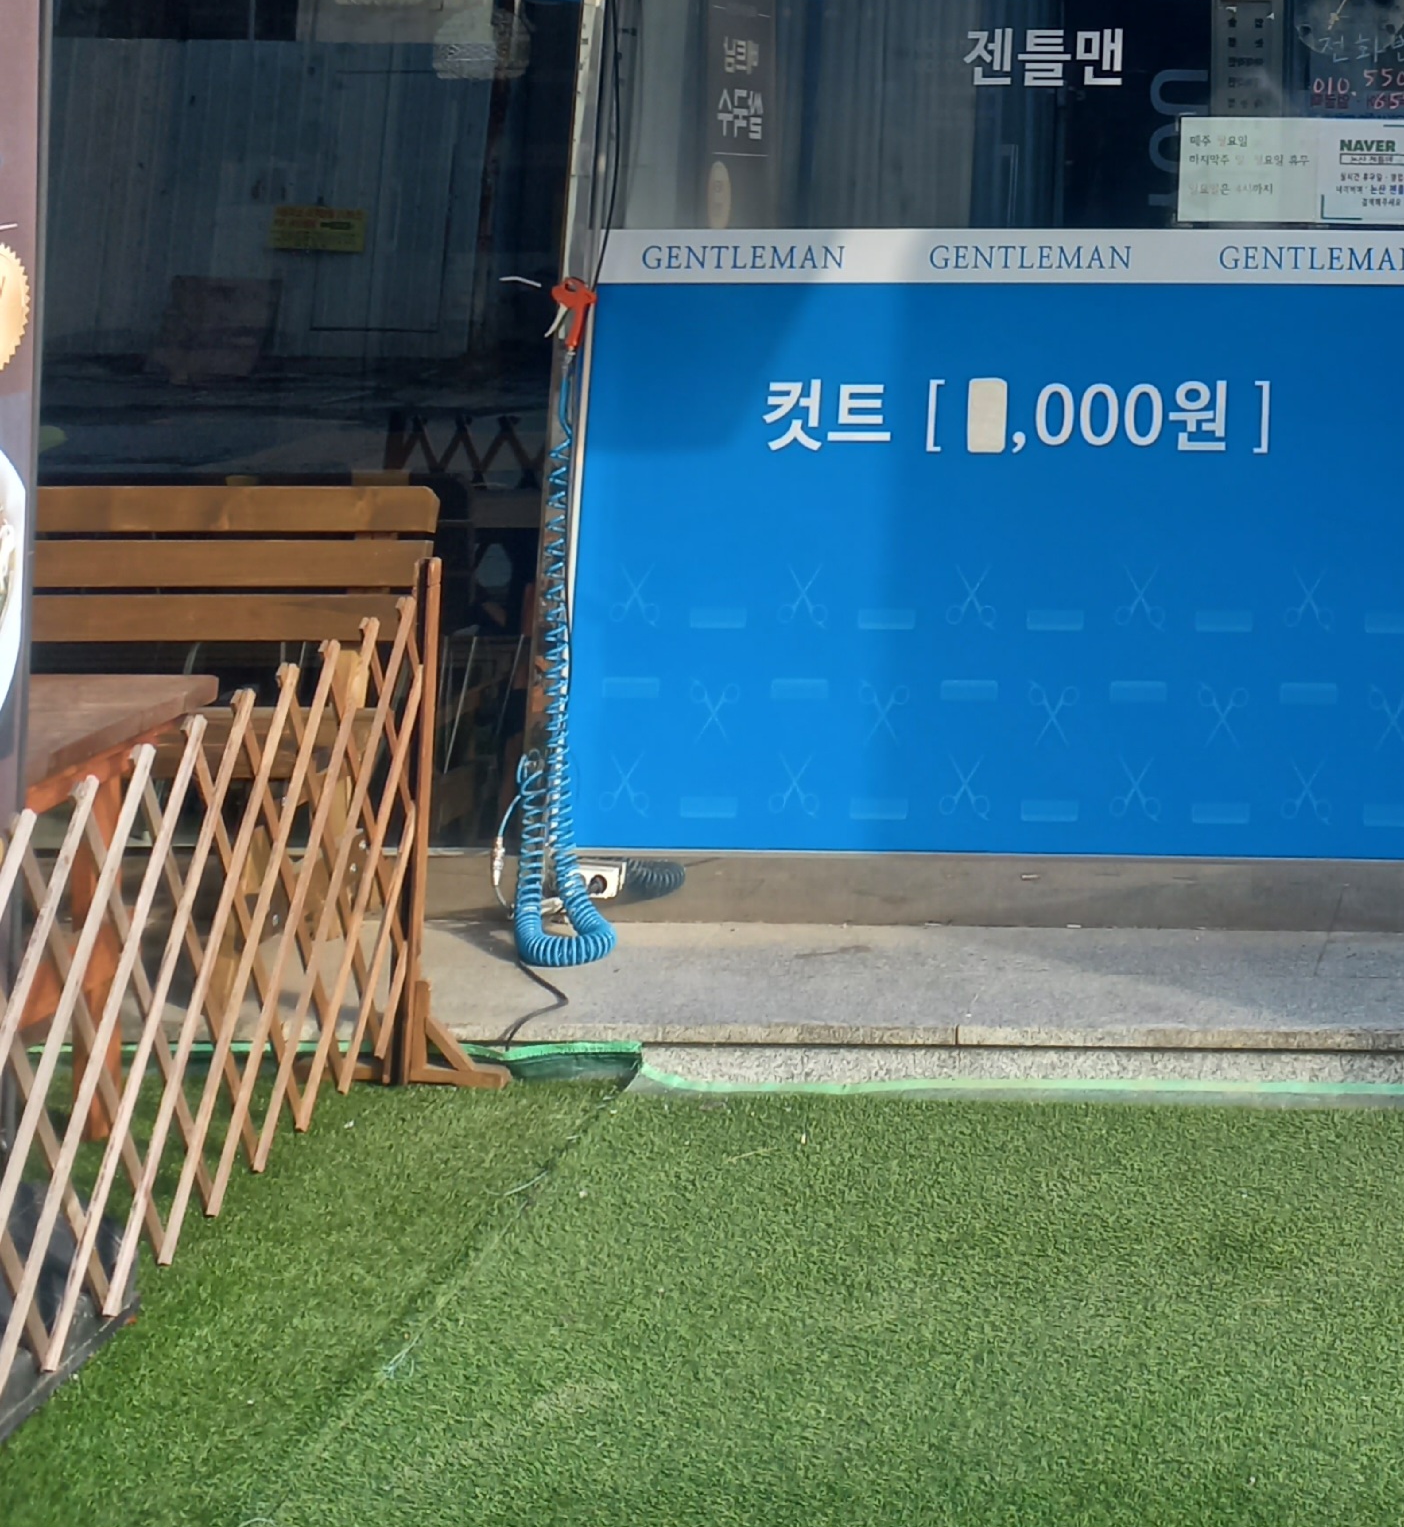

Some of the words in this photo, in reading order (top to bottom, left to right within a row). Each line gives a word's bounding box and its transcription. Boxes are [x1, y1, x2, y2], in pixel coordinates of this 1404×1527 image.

[963, 27, 1124, 86] 젠틀맨
[1339, 139, 1396, 152] NAVER
[641, 245, 845, 271] GENTLEMAN
[929, 245, 1132, 270] GENTLEMAN
[763, 380, 892, 452] 컷트
[966, 377, 1228, 453] ,000원
